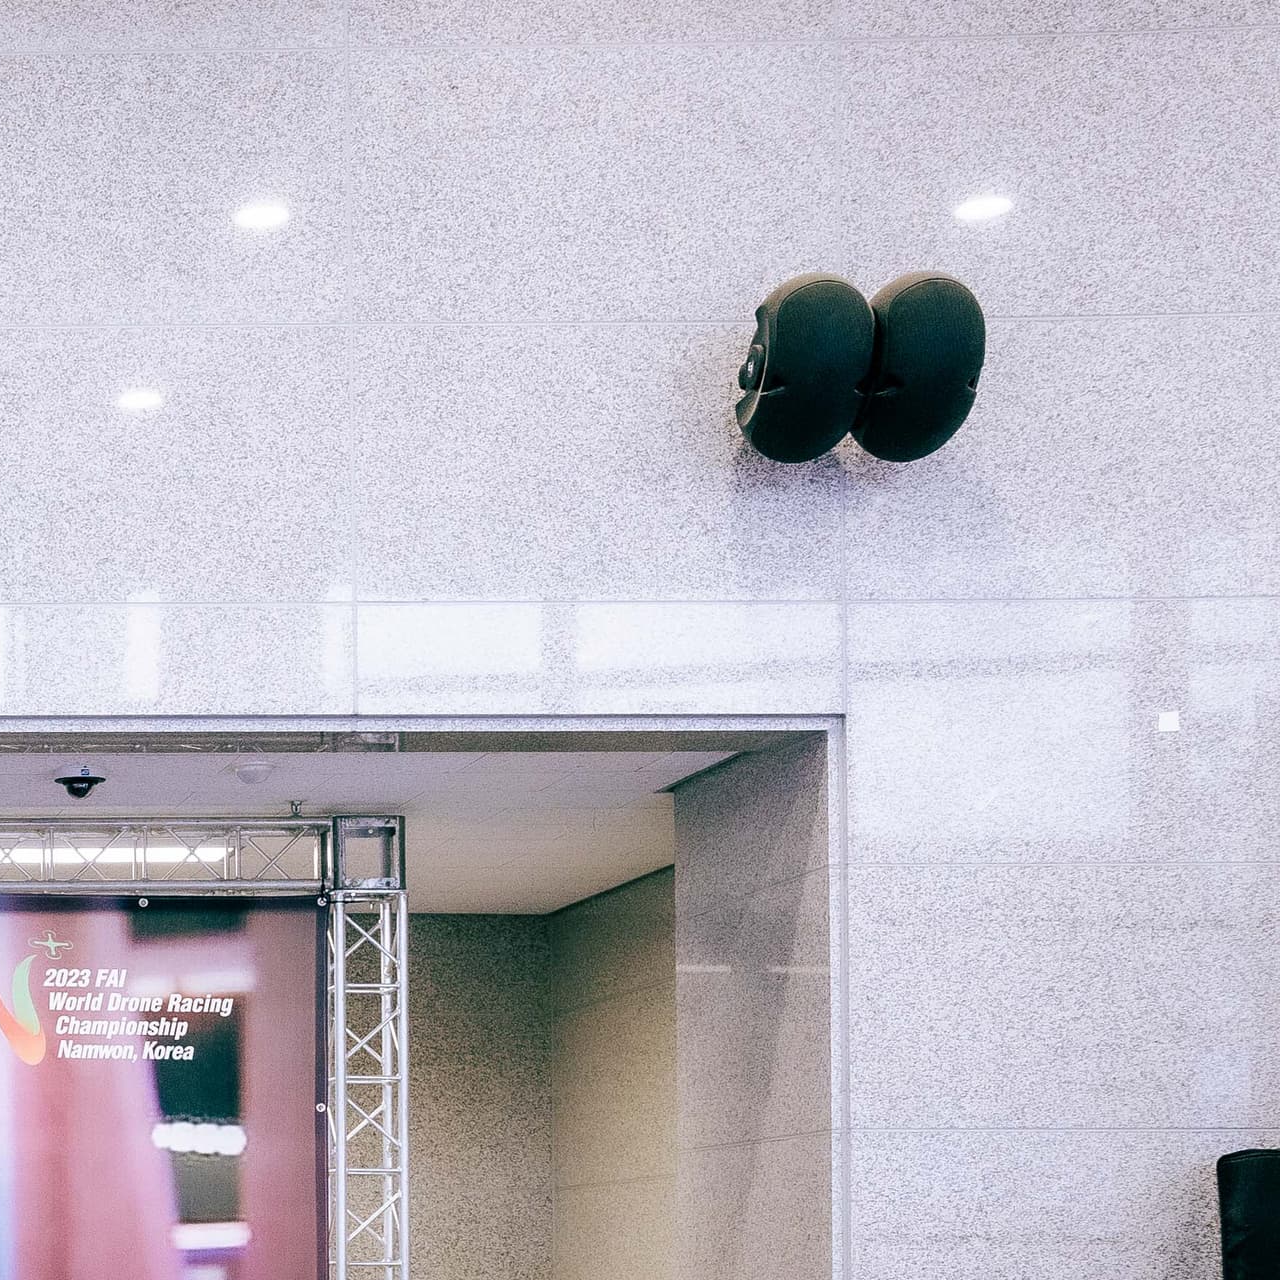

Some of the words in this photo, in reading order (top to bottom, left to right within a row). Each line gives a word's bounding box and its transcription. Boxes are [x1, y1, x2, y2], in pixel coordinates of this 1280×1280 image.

[44, 969, 90, 987] 2023
[96, 969, 126, 987] FAI
[49, 992, 103, 1012] World
[108, 993, 164, 1012] Drone
[168, 994, 233, 1016] Racing
[56, 1016, 187, 1040] Championship
[58, 1040, 137, 1063] Namwon,
[142, 1042, 194, 1060] Korea
